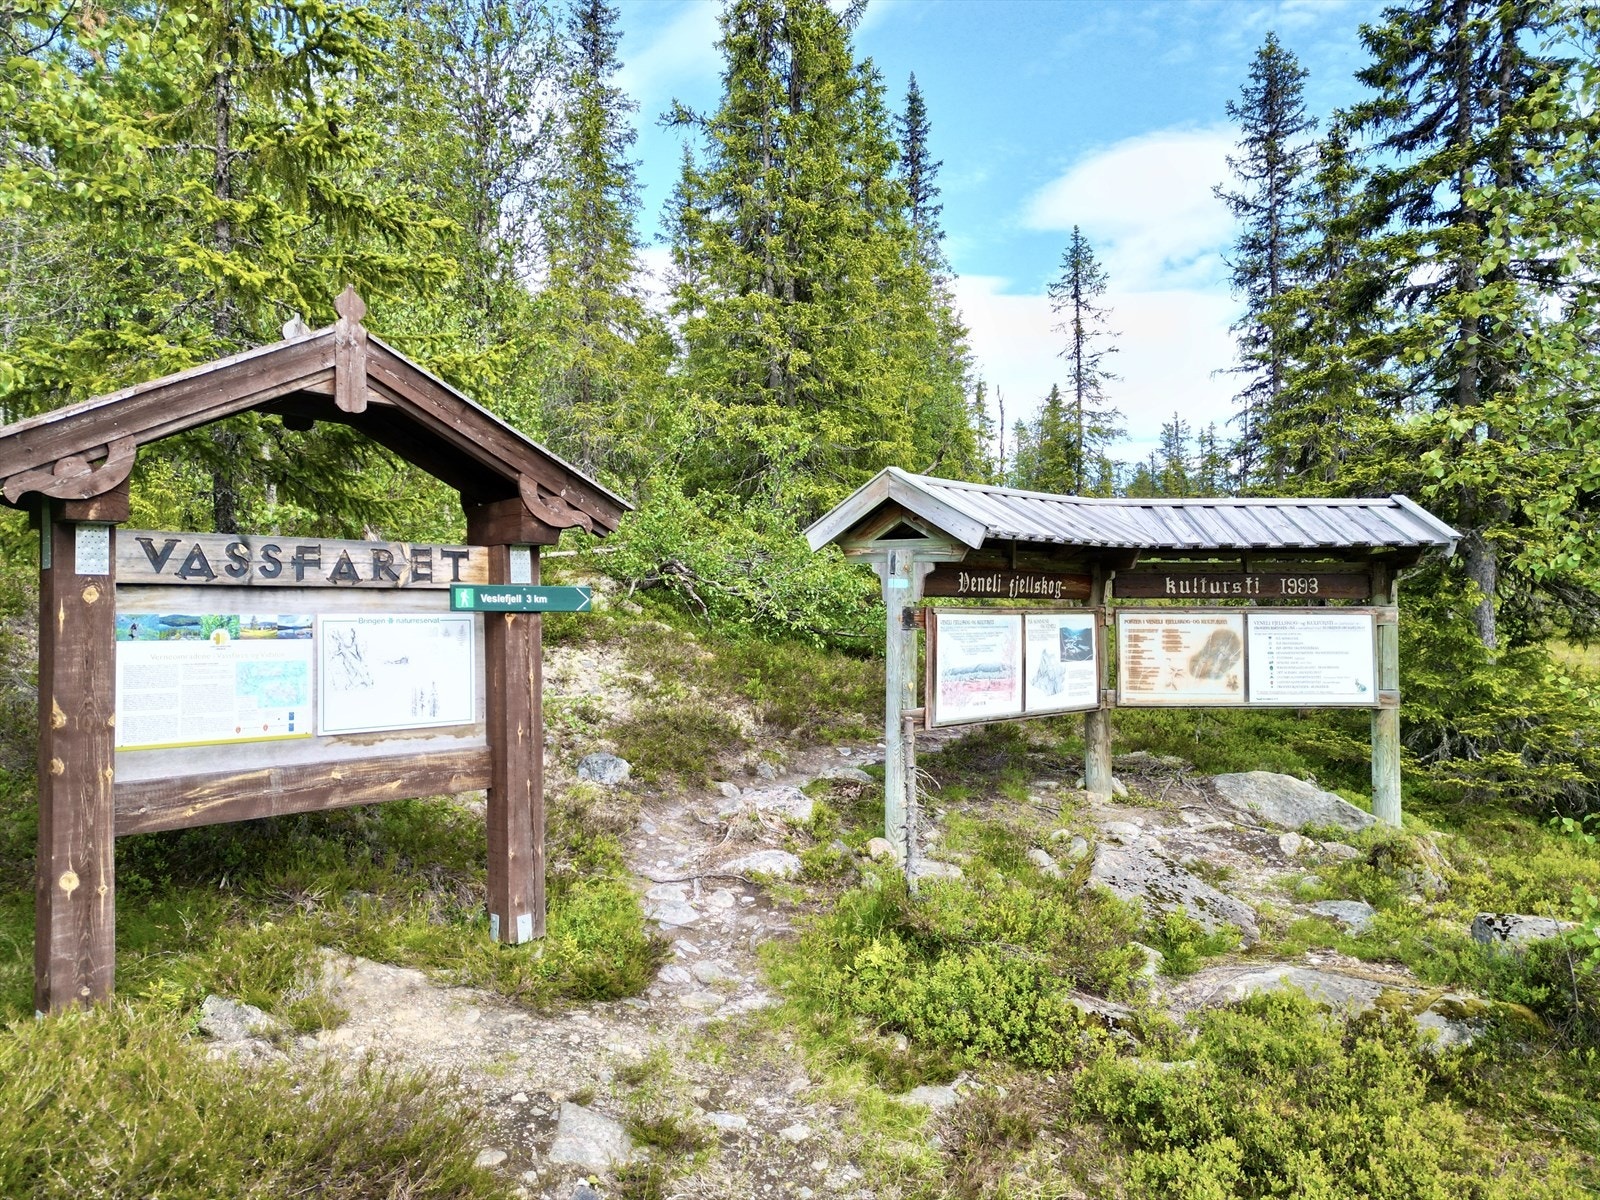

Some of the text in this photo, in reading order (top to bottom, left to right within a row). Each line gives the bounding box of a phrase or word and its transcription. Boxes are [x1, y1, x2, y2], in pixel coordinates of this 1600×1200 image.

[135, 537, 470, 584] VASSFARET
[958, 571, 1002, 593] Veneli
[1165, 576, 1319, 595] kultursti 1993
[480, 593, 547, 604] Veslefjell 3 km
[358, 617, 386, 625] Bringen
